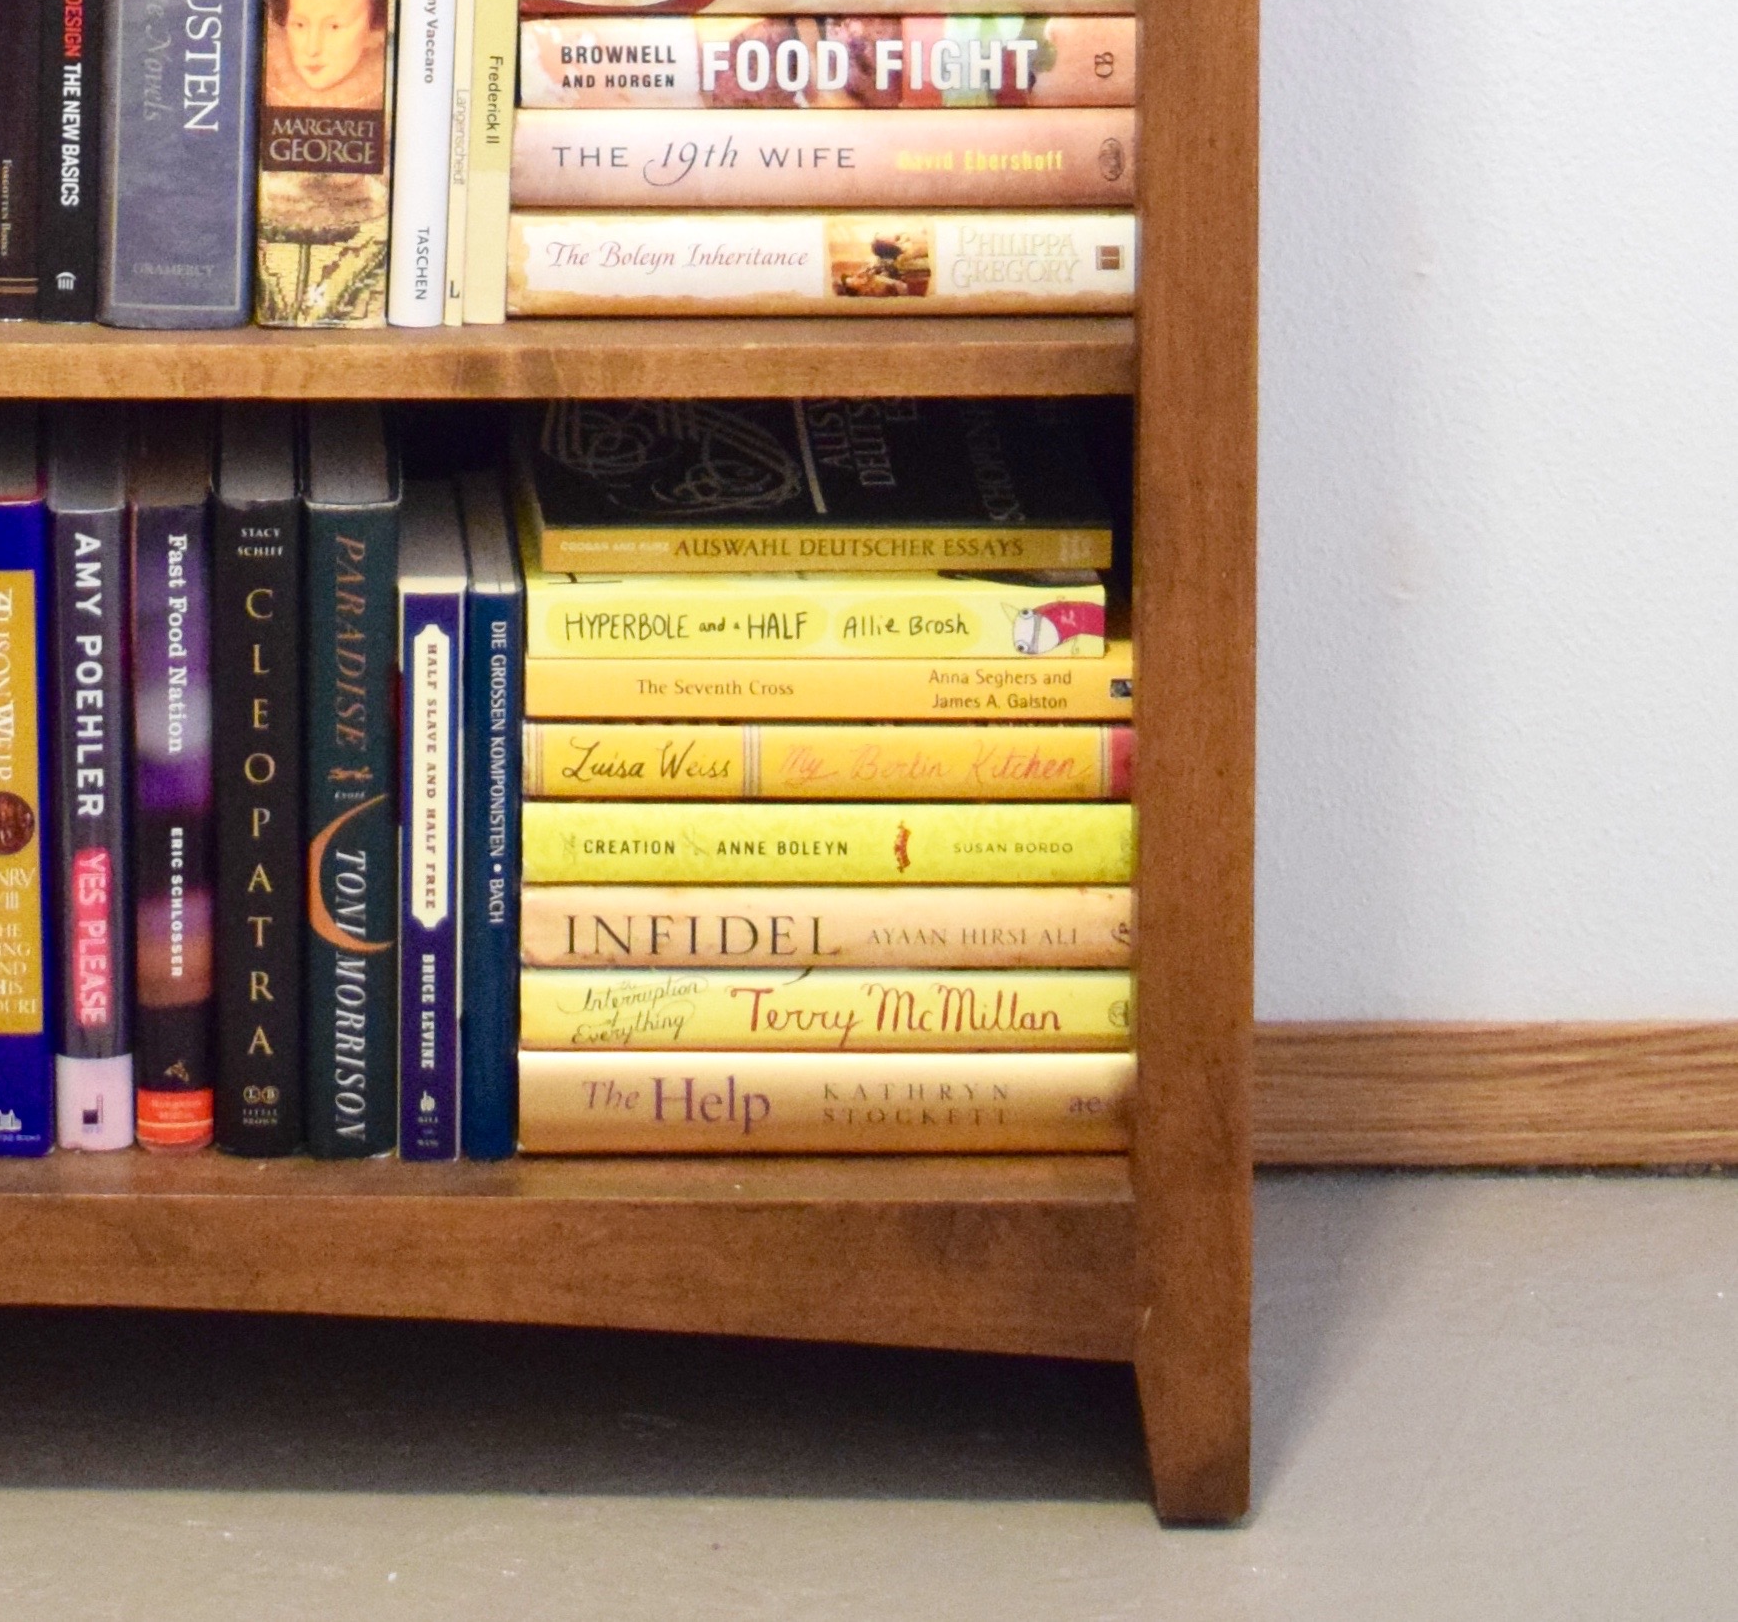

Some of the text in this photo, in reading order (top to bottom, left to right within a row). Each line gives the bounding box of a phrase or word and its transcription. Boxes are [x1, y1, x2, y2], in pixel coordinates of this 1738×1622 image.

[562, 46, 677, 64] BROWNELL
[702, 39, 1038, 90] FOOD FIGHT
[562, 72, 676, 88] AND HORGEN
[271, 118, 376, 138] MARGARET
[269, 139, 375, 164] GEORGE
[565, 612, 689, 641] HYPERBOLE
[699, 620, 725, 634] and
[747, 612, 807, 639] HALF
[843, 615, 969, 638] Allie Brosh
[74, 533, 105, 819] AMY POEHLER
[563, 914, 841, 957] INFIDEL
[730, 983, 1062, 1047] Terry McMillan
[583, 1074, 771, 1135] The Help
